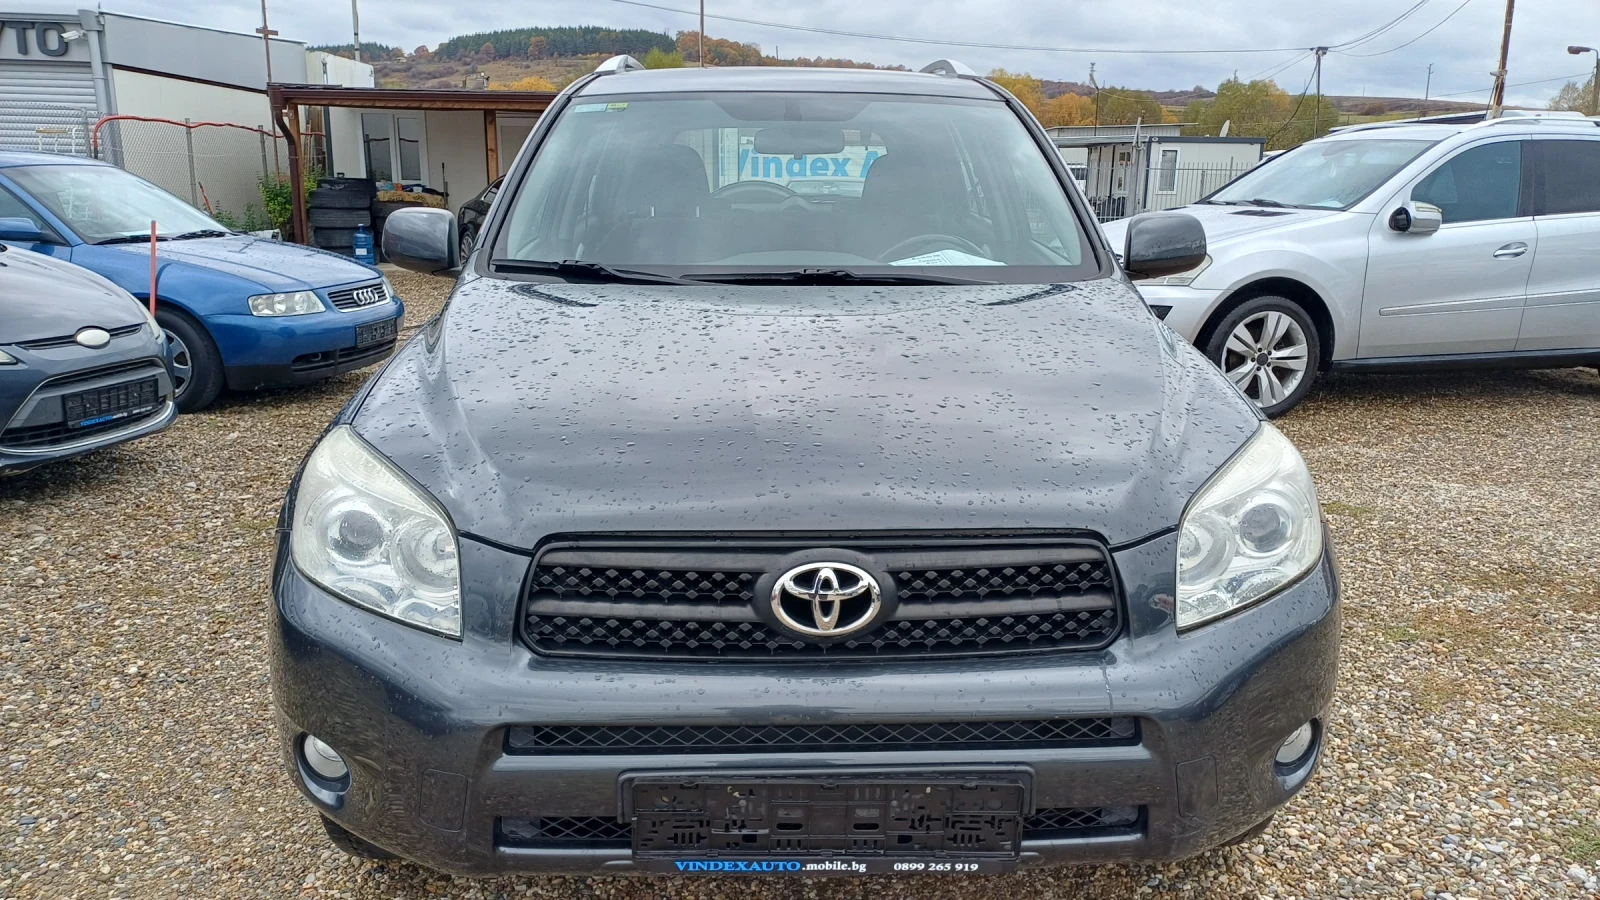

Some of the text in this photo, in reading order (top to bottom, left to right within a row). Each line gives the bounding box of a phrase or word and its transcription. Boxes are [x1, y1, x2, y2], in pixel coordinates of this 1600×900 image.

[0, 21, 69, 57] TO
[893, 862, 925, 871] 0899
[927, 862, 951, 871] 265
[955, 862, 979, 872] 919
